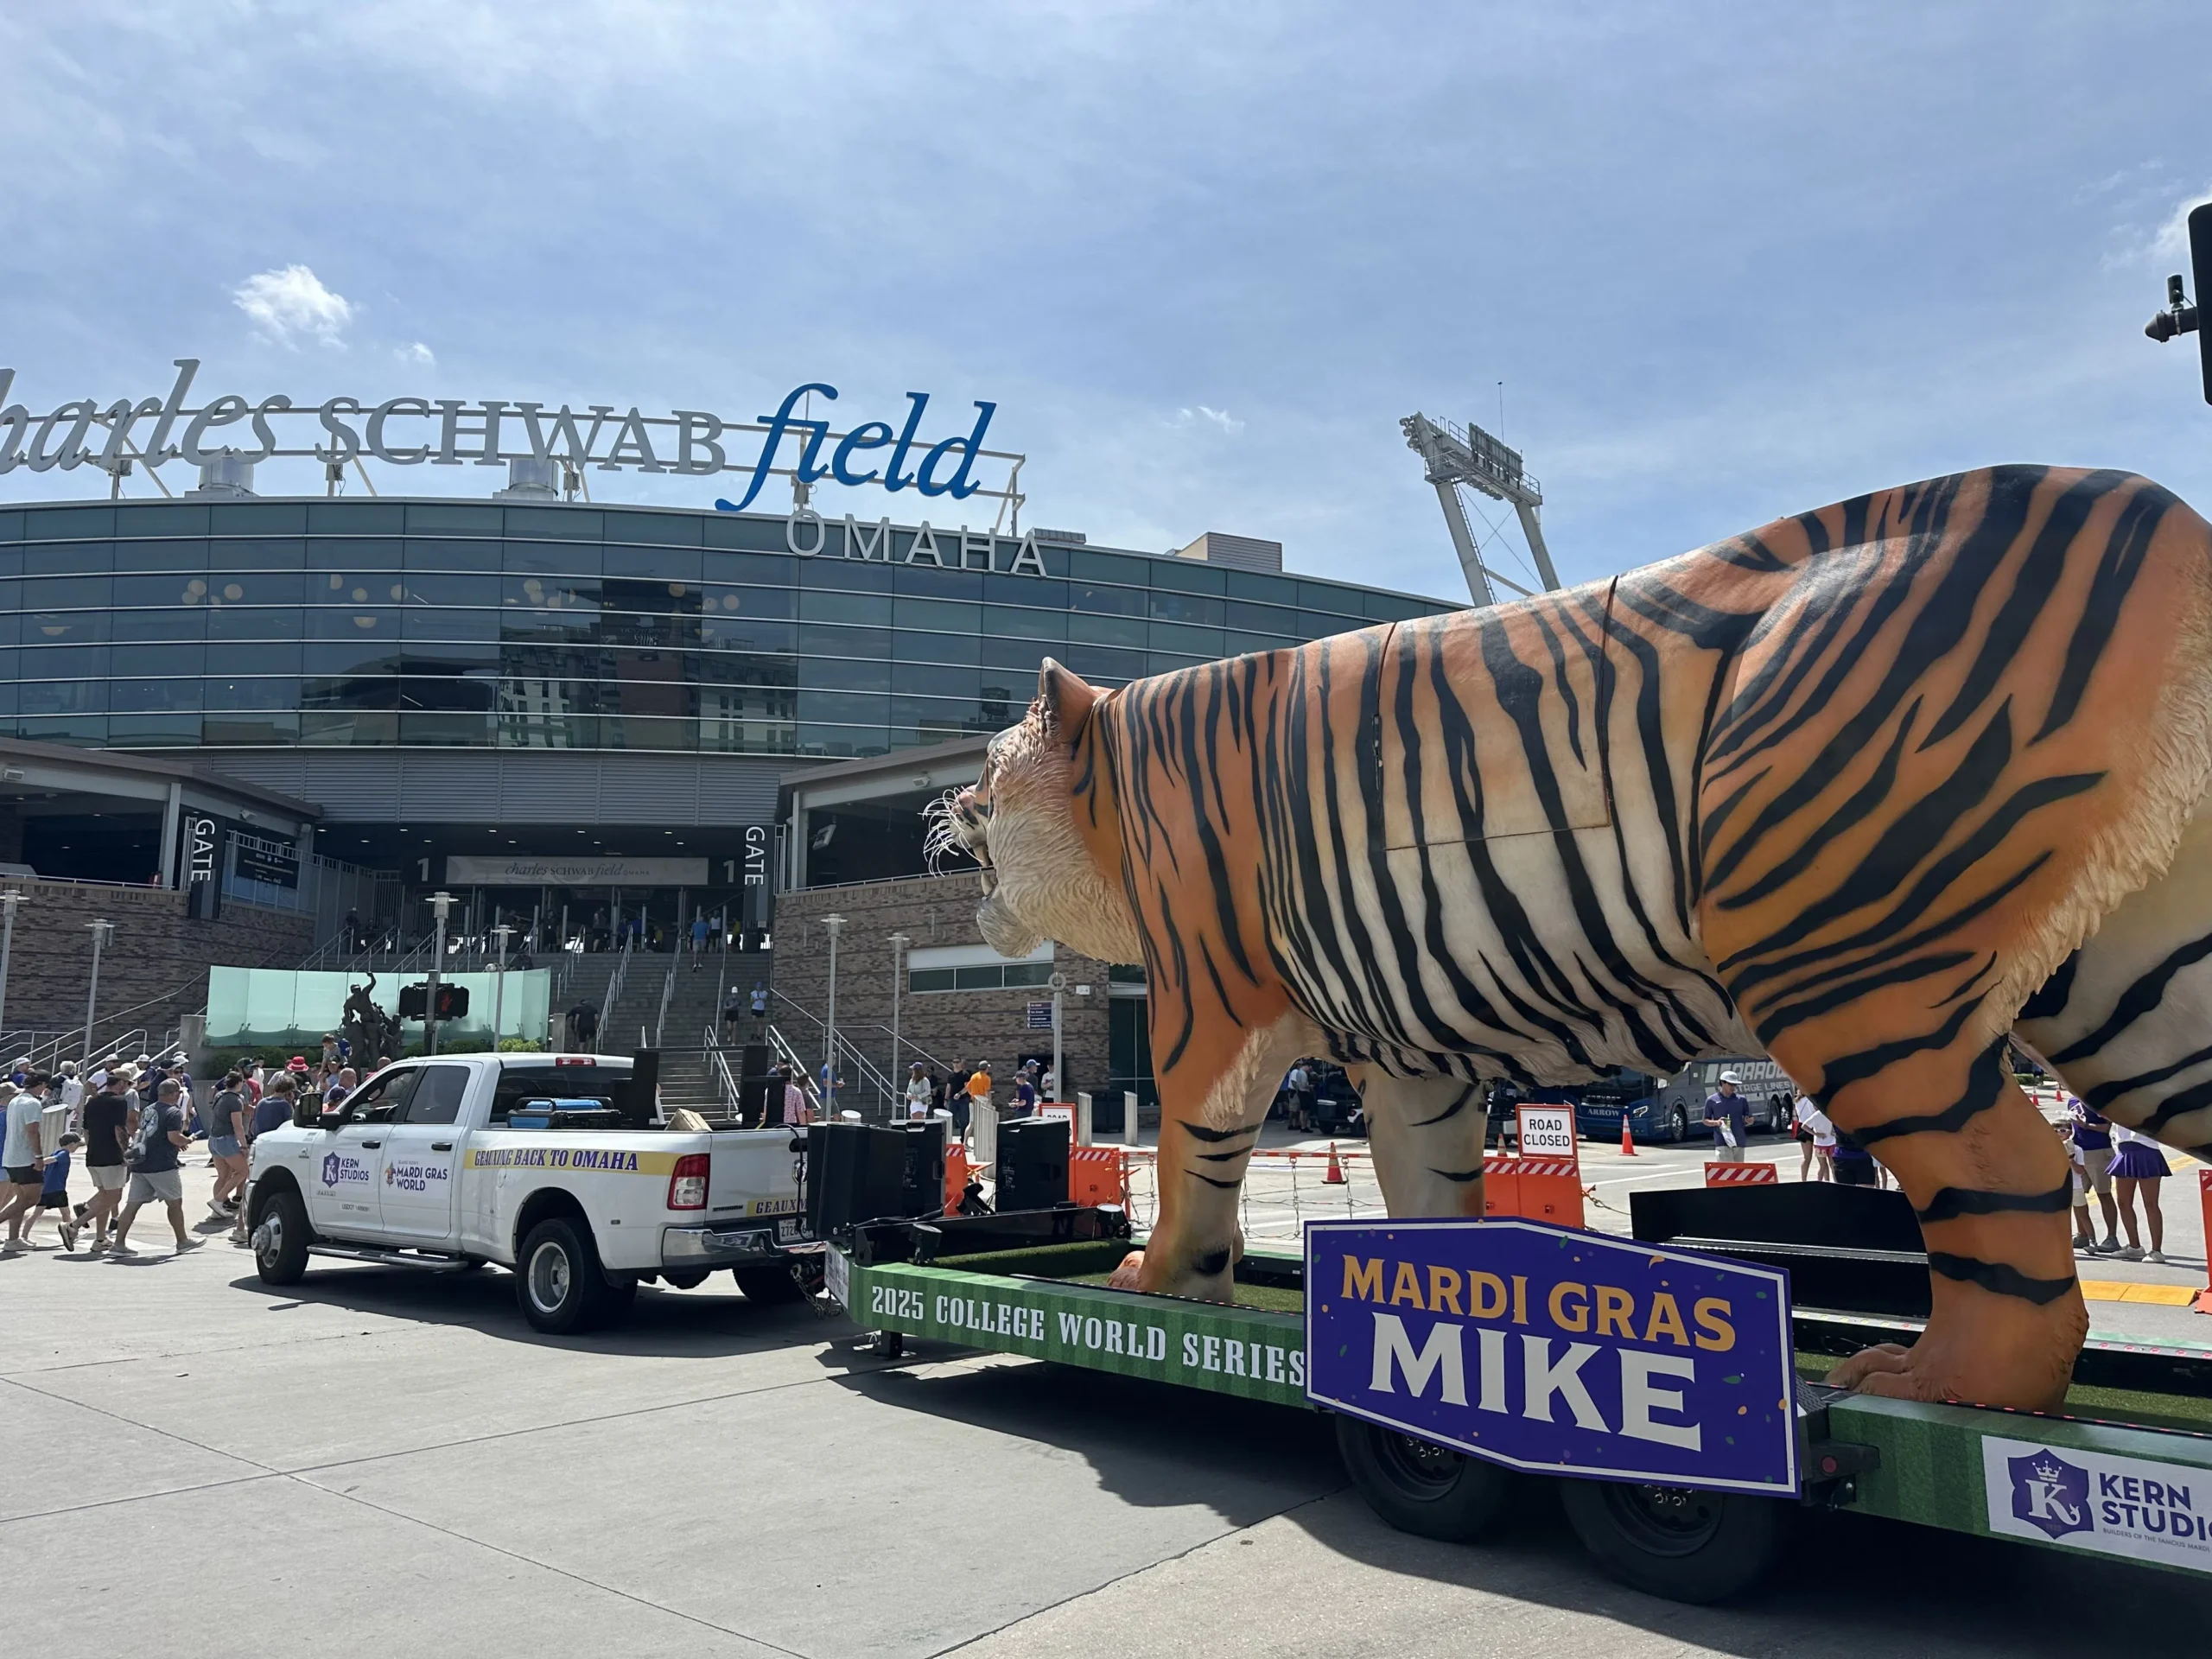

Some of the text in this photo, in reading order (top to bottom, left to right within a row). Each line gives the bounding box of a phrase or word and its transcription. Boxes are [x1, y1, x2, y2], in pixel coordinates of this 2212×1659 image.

[315, 397, 725, 475] SCHWAB
[715, 383, 996, 512] field
[786, 509, 1047, 576] OMAHA
[190, 819, 215, 881] GATE
[744, 826, 766, 886] GATE
[416, 857, 429, 881] 1
[505, 862, 549, 876] charles
[550, 867, 594, 875] SCHWAB
[591, 863, 623, 880] field
[723, 860, 734, 883] 1
[1764, 1081, 1790, 1091] LINES
[1529, 1118, 1562, 1130] ROAD
[1523, 1134, 1570, 1147] CLOSED
[340, 1158, 360, 1168] KERN
[475, 1149, 639, 1171] GEAUXING BACK TO OMAHA
[340, 1169, 369, 1181] STUDIOS
[397, 1166, 448, 1180] MARDI GRAS
[397, 1178, 426, 1191] WORLD
[1341, 1255, 1736, 1352] MARDI GRAS
[872, 1285, 1305, 1387] 2025 COLLEGE WORLD SERIES
[1368, 1312, 1701, 1452] MIKE
[2099, 1471, 2192, 1511] KERN
[2101, 1500, 2212, 1542] STUDI
[2102, 1527, 2133, 1539] BUILDERS
[2145, 1535, 2157, 1543] THE
[2158, 1537, 2186, 1548] FAMOUS
